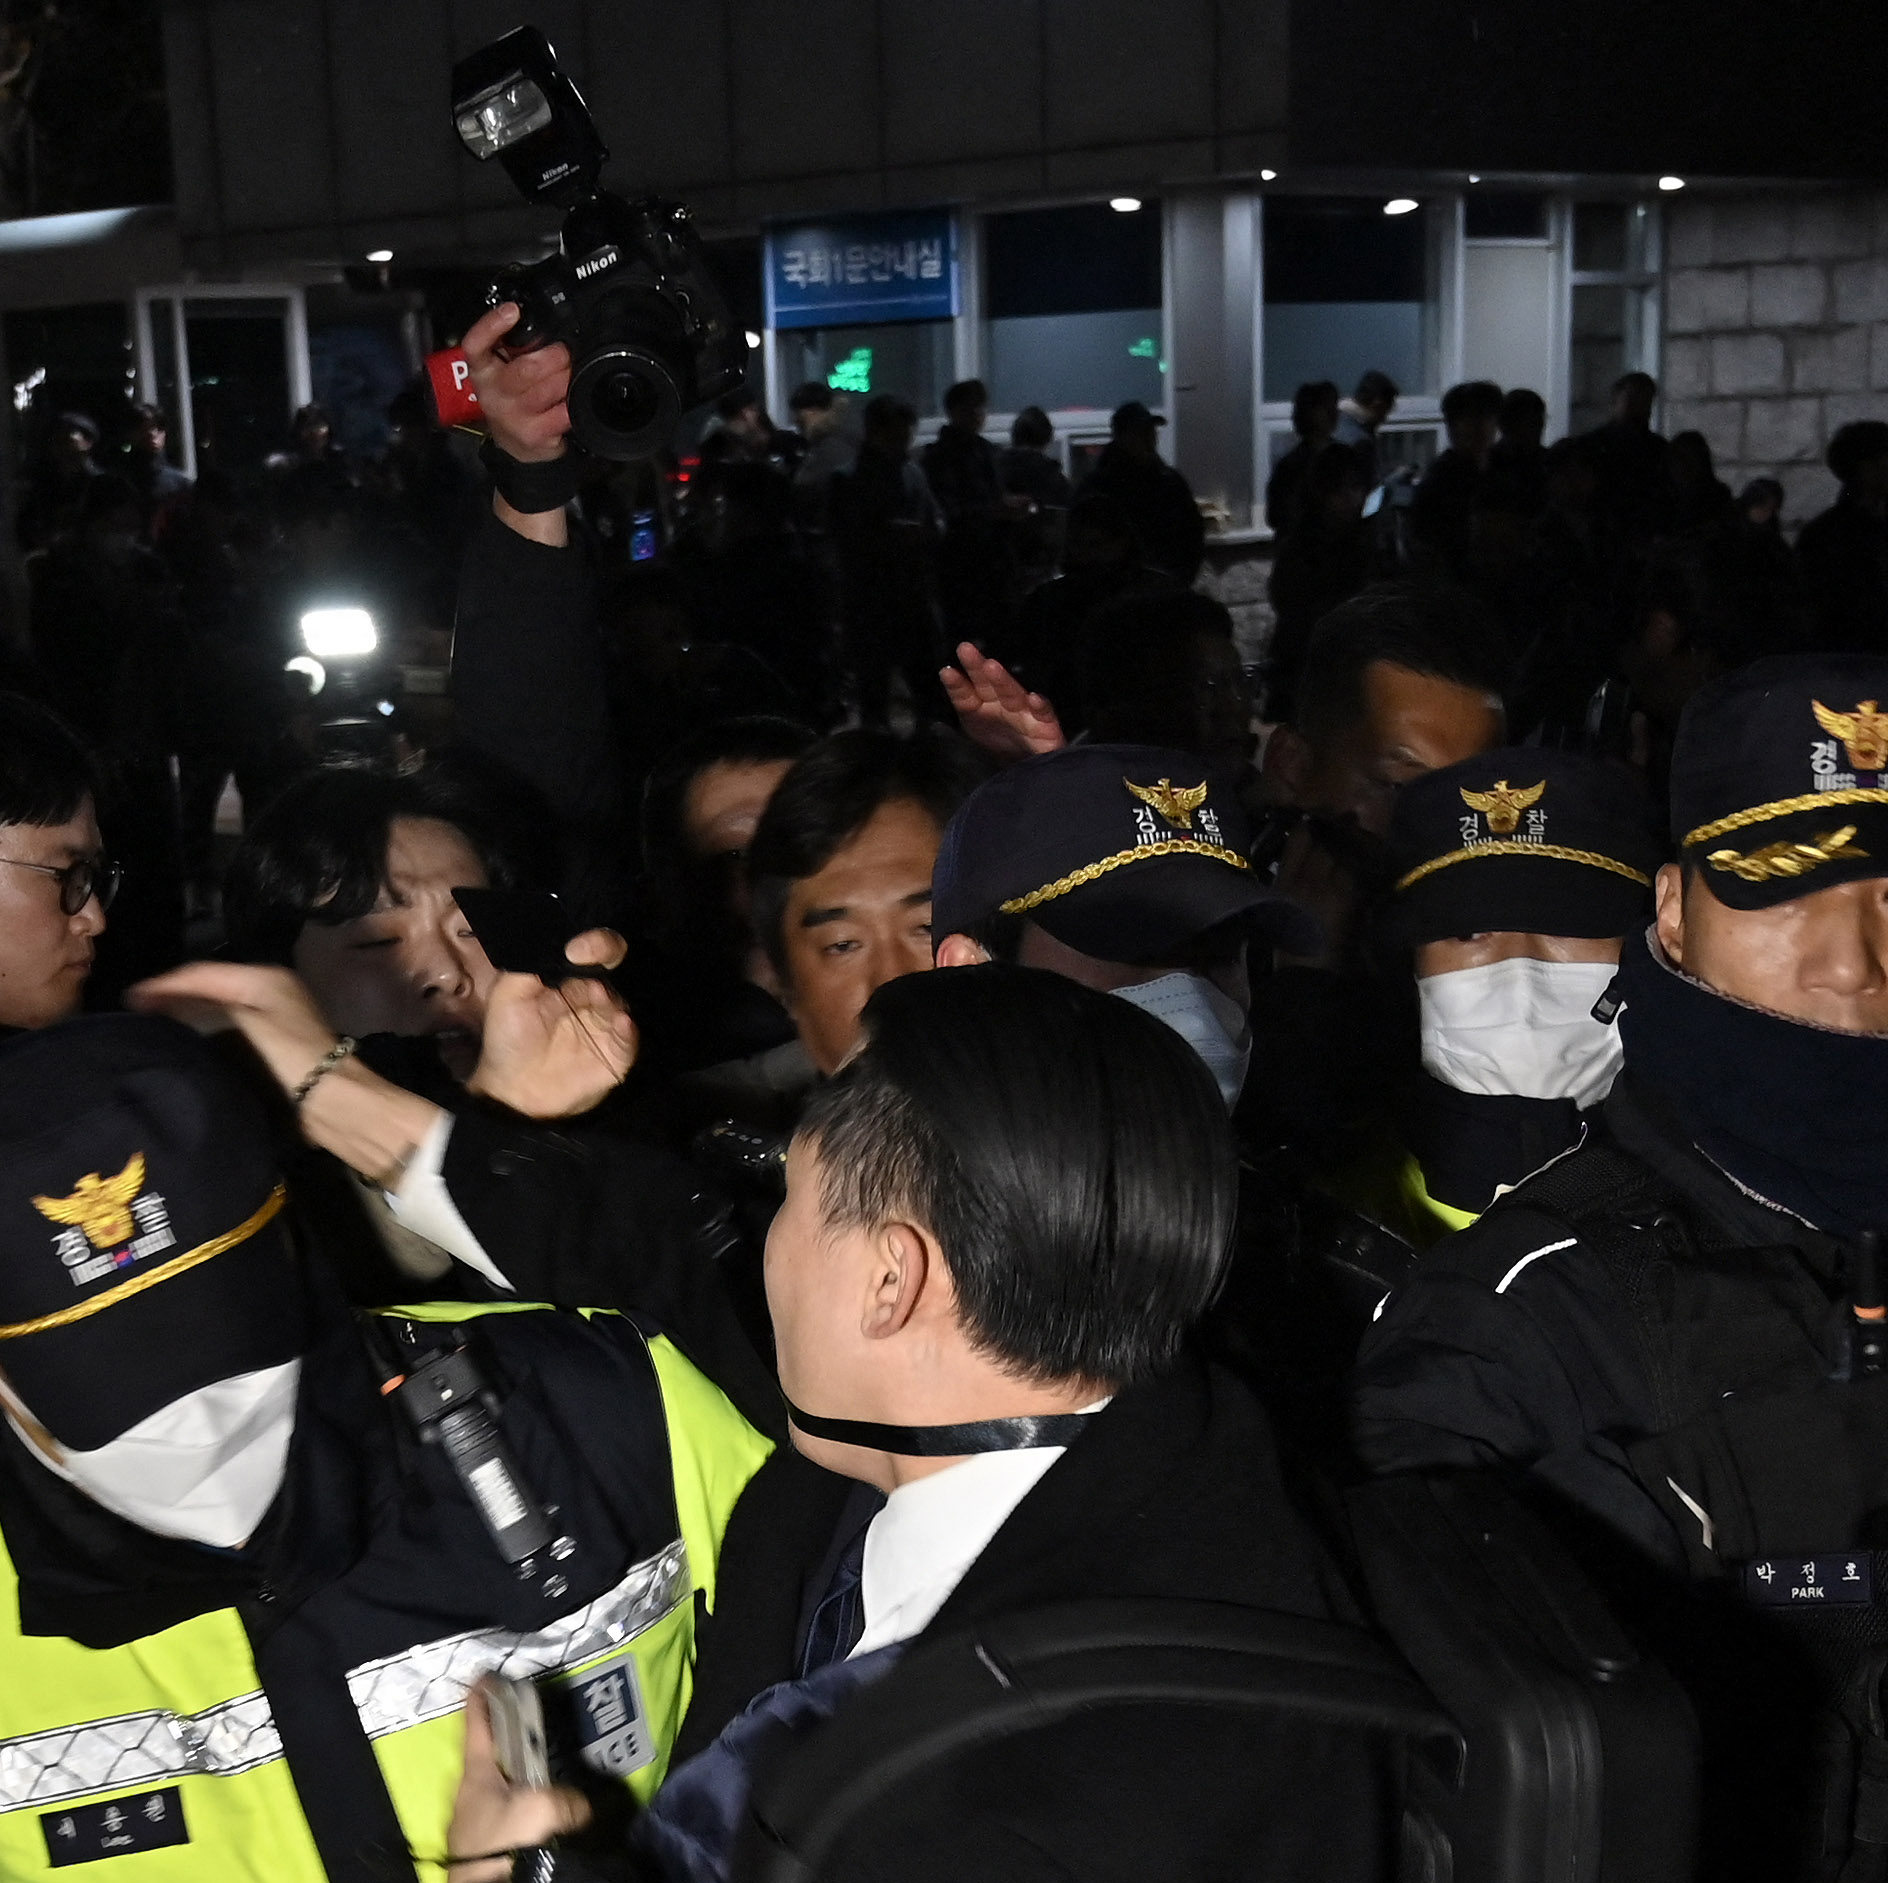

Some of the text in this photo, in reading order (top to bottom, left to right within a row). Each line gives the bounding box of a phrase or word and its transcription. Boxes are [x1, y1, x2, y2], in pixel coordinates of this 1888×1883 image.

[542, 162, 569, 181] Nikon
[575, 251, 618, 281] Nikon
[1791, 1586, 1825, 1599] PARK
